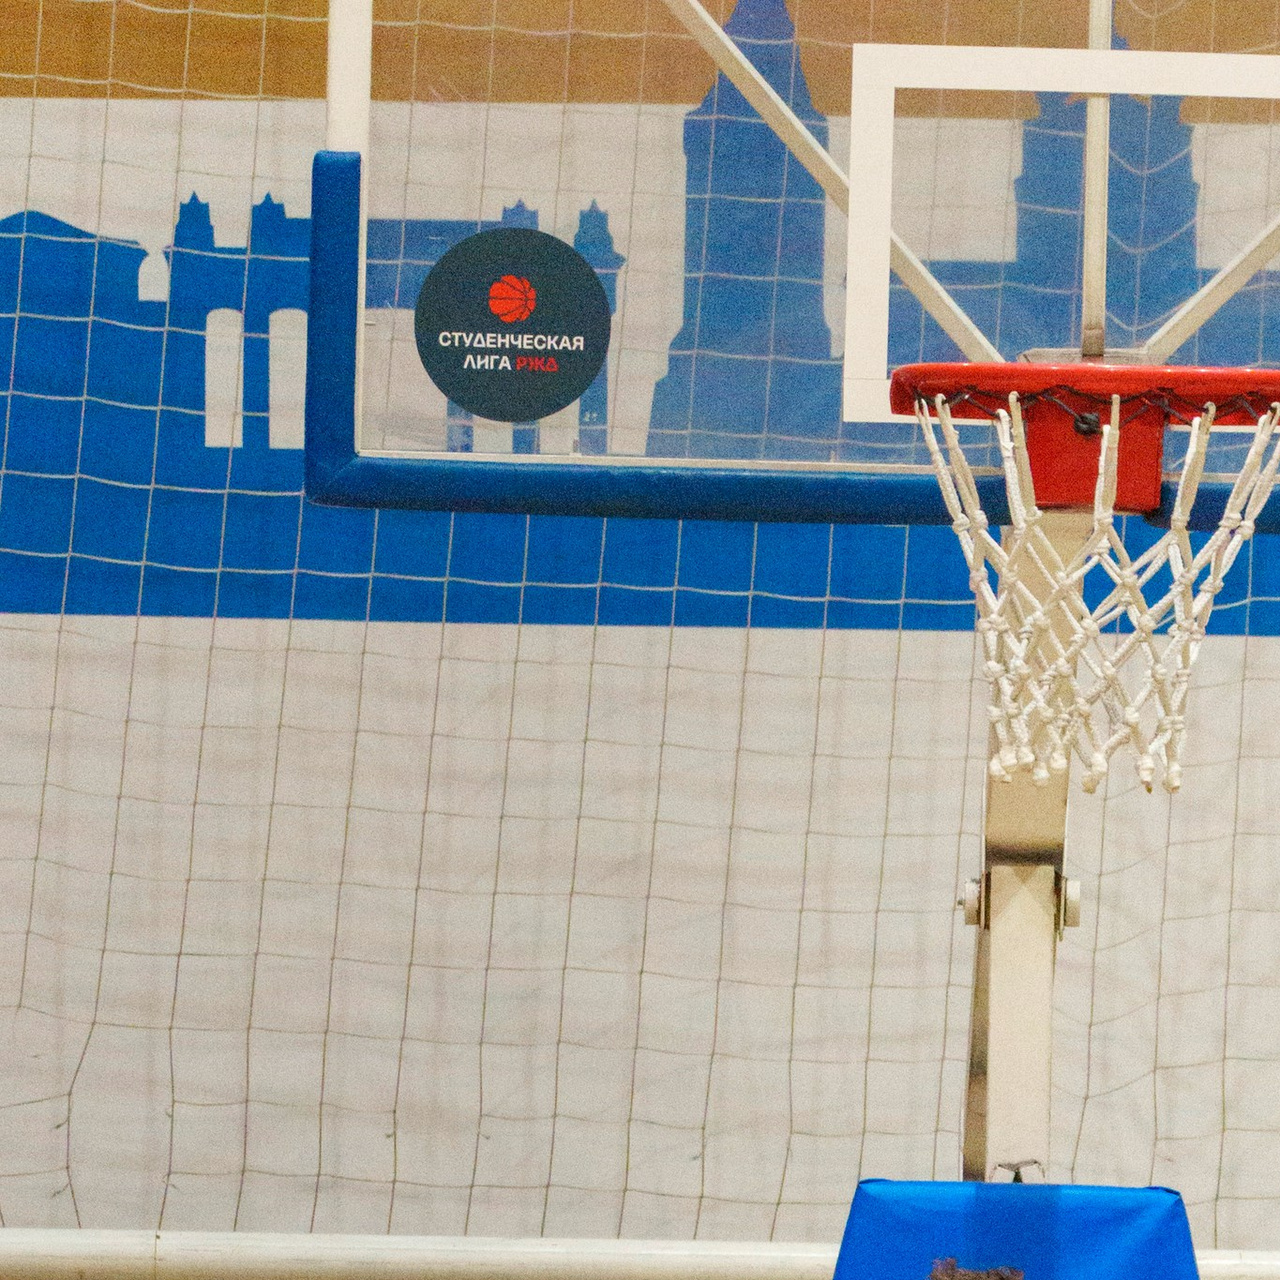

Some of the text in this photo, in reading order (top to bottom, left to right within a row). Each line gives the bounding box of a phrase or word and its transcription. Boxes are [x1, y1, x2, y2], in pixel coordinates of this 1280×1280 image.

[438, 331, 585, 351] СТУДЕНЧЕСКАЯ
[463, 354, 559, 372] ЛИГА РЖД
